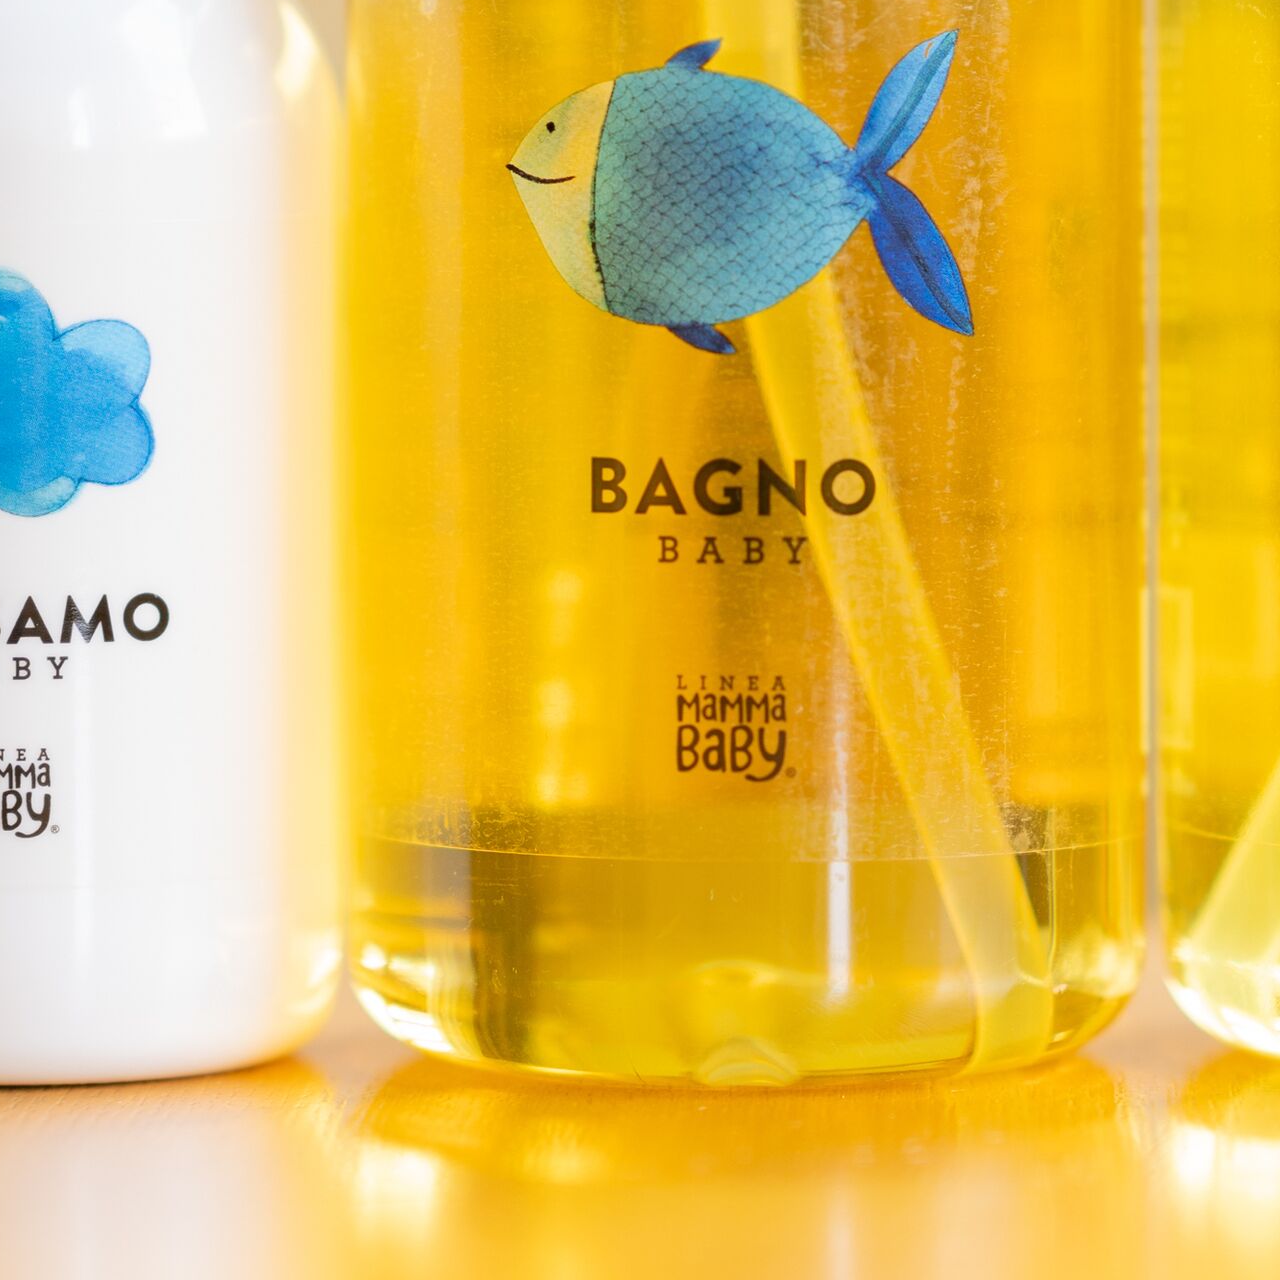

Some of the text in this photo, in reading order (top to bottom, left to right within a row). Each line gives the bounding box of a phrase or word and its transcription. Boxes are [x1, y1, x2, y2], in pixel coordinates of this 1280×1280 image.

[590, 456, 876, 517] BAGNO
[658, 535, 808, 565] BABY
[676, 674, 786, 692] LINEA
